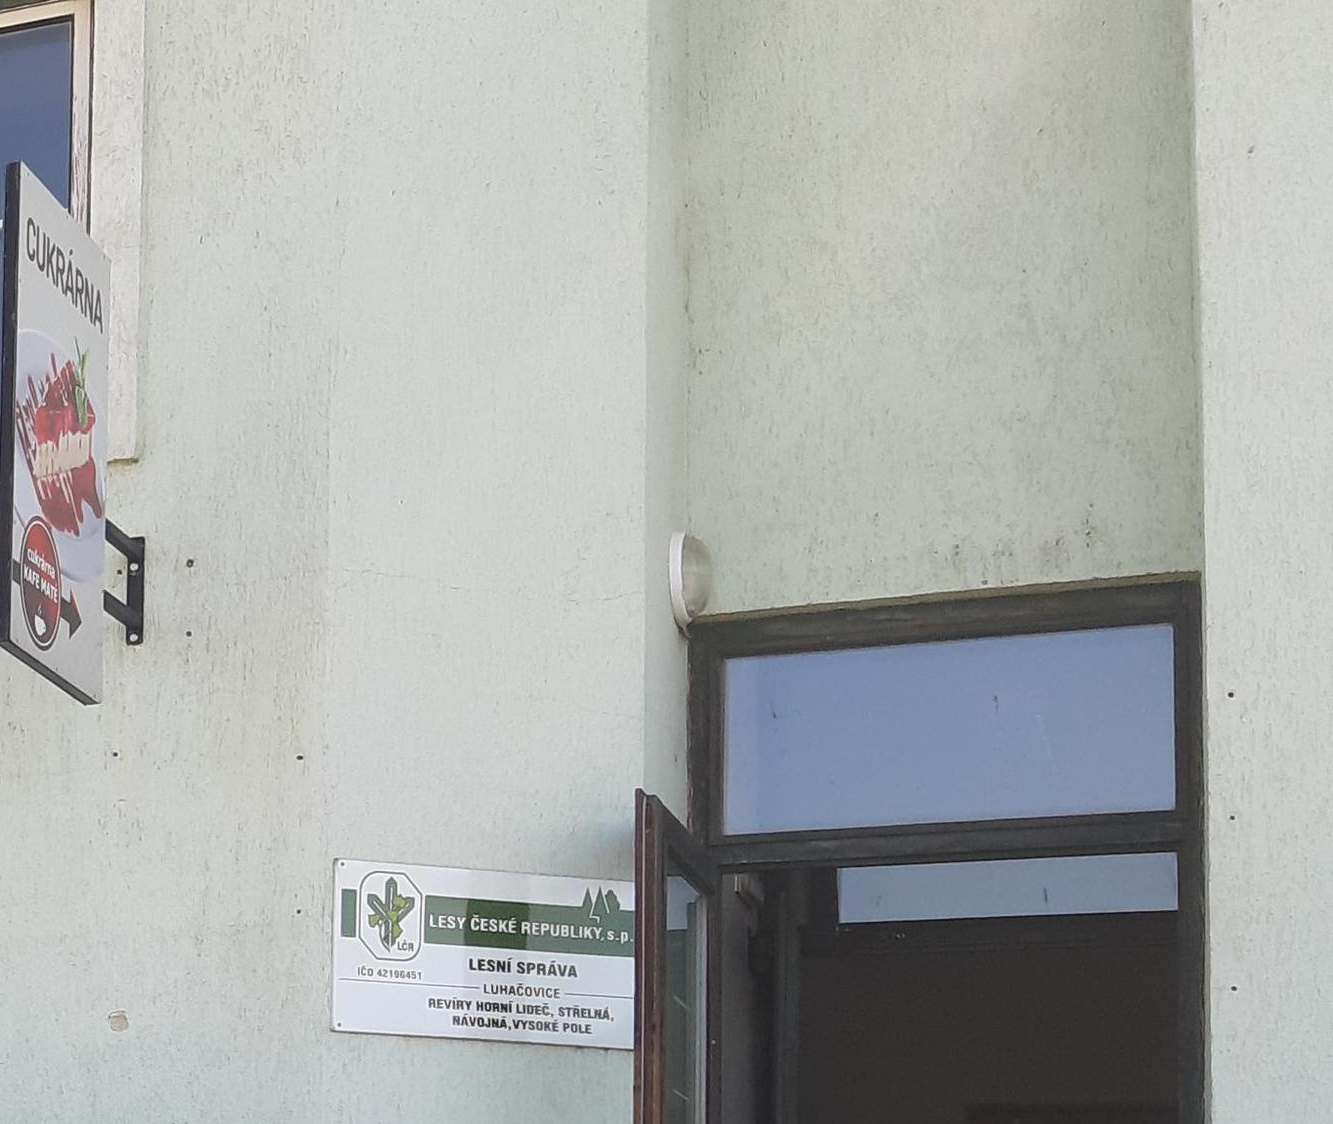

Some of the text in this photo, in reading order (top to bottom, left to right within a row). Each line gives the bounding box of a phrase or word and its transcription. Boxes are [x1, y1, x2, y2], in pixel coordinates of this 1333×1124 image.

[26, 216, 104, 335] CUKRÁRNA
[429, 913, 466, 930] LESY
[470, 913, 517, 934] ČESKÉ
[468, 956, 578, 978] LESNÍ SPRÁVA
[483, 981, 560, 999] LUHAČOVICE
[428, 997, 615, 1022] REVÍRY HORNÍ LIDEČ, STŘELNÁ,
[562, 1022, 593, 1035] POLE
